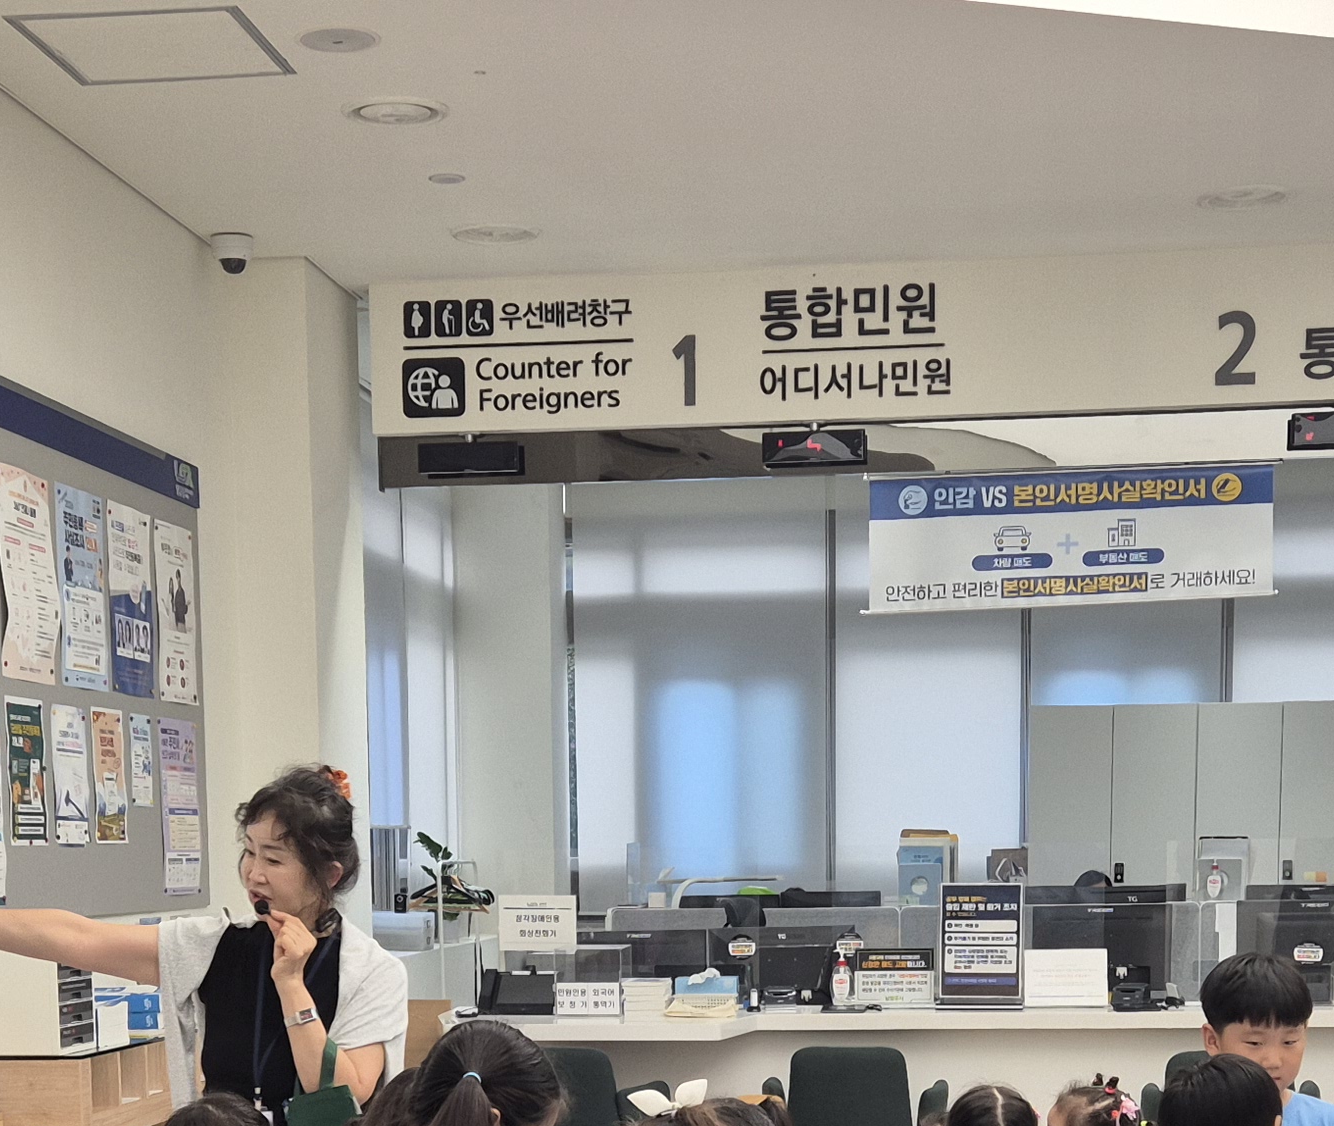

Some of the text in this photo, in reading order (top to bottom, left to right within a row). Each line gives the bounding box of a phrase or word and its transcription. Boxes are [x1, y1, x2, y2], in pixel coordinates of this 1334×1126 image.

[498, 297, 633, 330] 우선배려창구
[759, 282, 938, 342] 통합민원
[1215, 310, 1256, 386] 2
[474, 351, 633, 382] Counter for
[672, 335, 697, 406] 1
[759, 357, 953, 402] 어디서나민원
[477, 386, 621, 415] Foreigners
[933, 477, 1207, 510] 인감 VS 본인서명사실확인서
[885, 583, 947, 603] 안전하고
[951, 580, 999, 600] 편리한
[1170, 569, 1257, 589] 거래하세요!
[592, 988, 615, 997] 외국어
